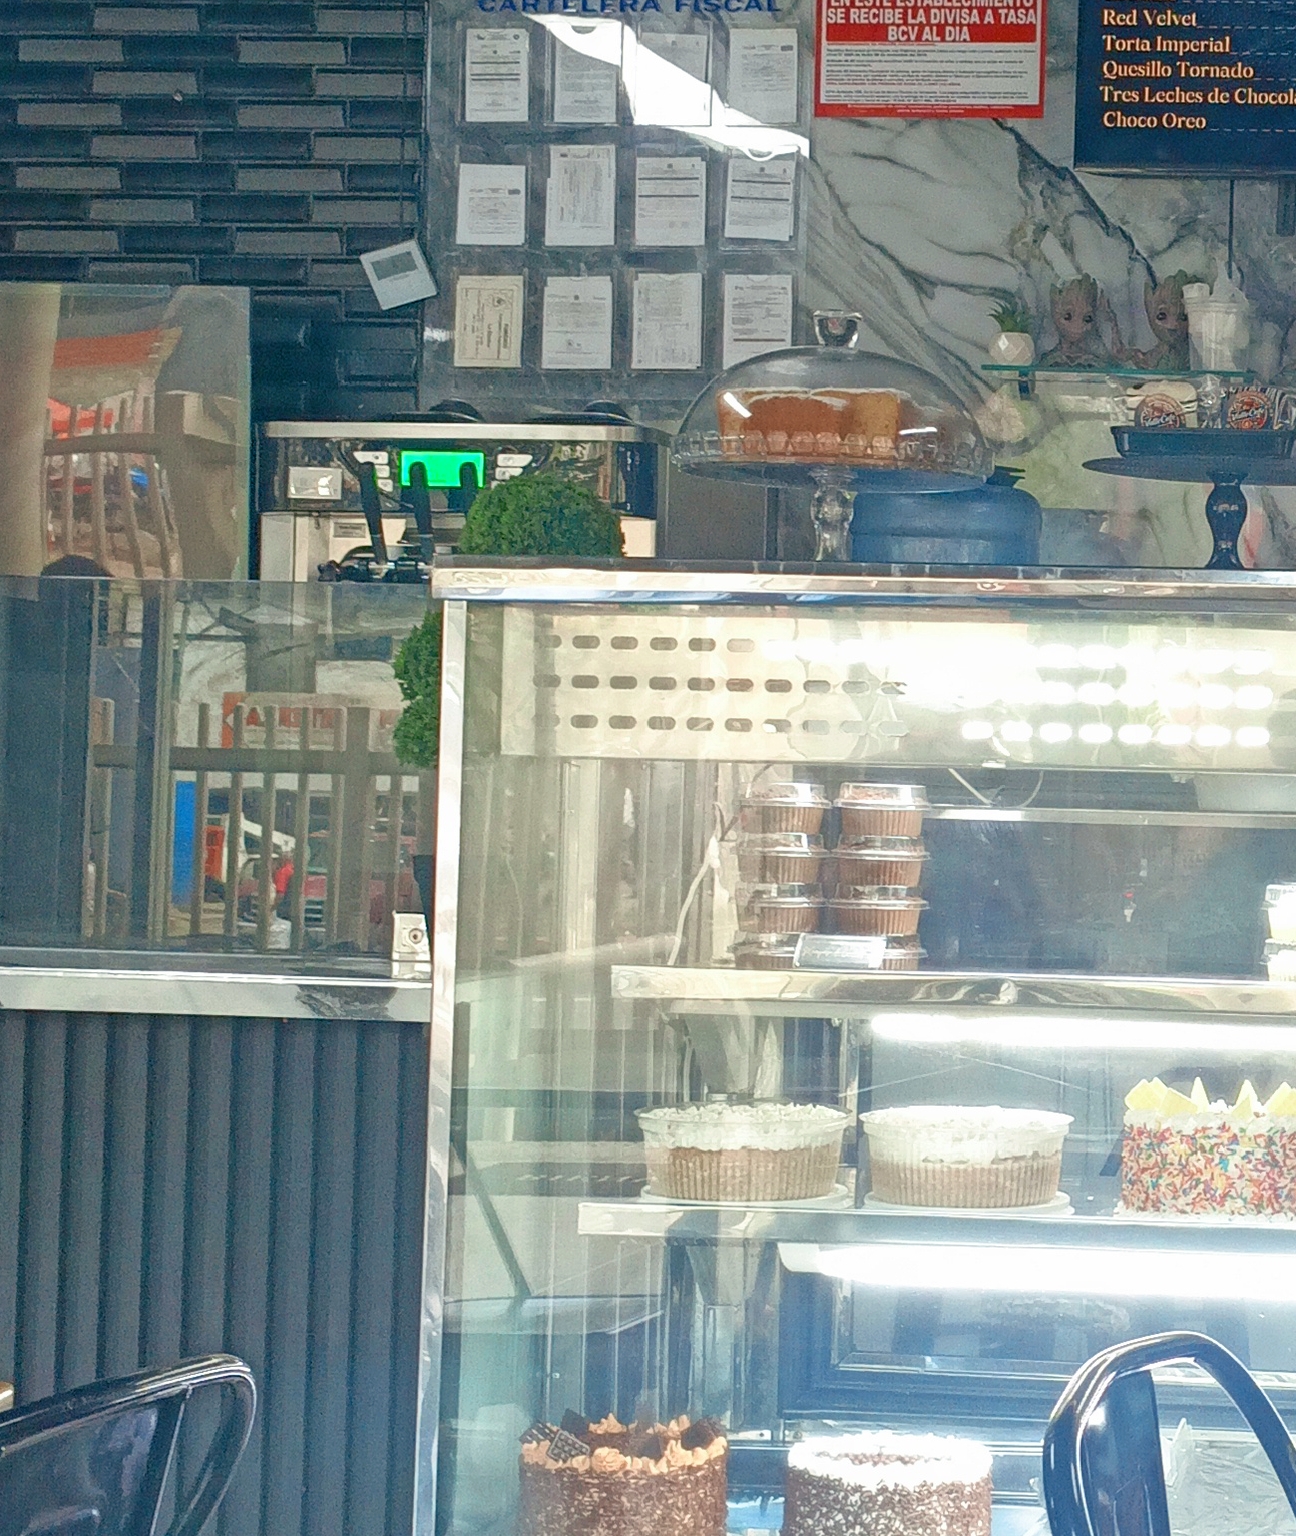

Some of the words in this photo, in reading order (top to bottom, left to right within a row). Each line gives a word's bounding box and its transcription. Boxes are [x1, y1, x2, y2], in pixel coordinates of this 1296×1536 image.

[827, 8, 847, 25] SE
[850, 8, 903, 25] RECIBE
[907, 9, 928, 25] LA
[930, 9, 980, 25] DIVISA
[983, 9, 995, 25] A
[999, 9, 1037, 25] TASA
[1103, 9, 1137, 26] Red
[1143, 10, 1197, 27] Velvet
[887, 26, 918, 42] BCV
[921, 26, 940, 42] AL
[945, 26, 970, 42] DIA
[1102, 35, 1151, 52] Torta
[1156, 36, 1230, 56] Imperial
[1103, 61, 1172, 80] Quesillo
[1176, 61, 1254, 80] Tornado
[1099, 86, 1140, 103] Tres
[1144, 87, 1203, 104] Leches
[1208, 88, 1230, 104] de
[1103, 112, 1158, 129] Choco
[1162, 113, 1206, 130] Oreo
